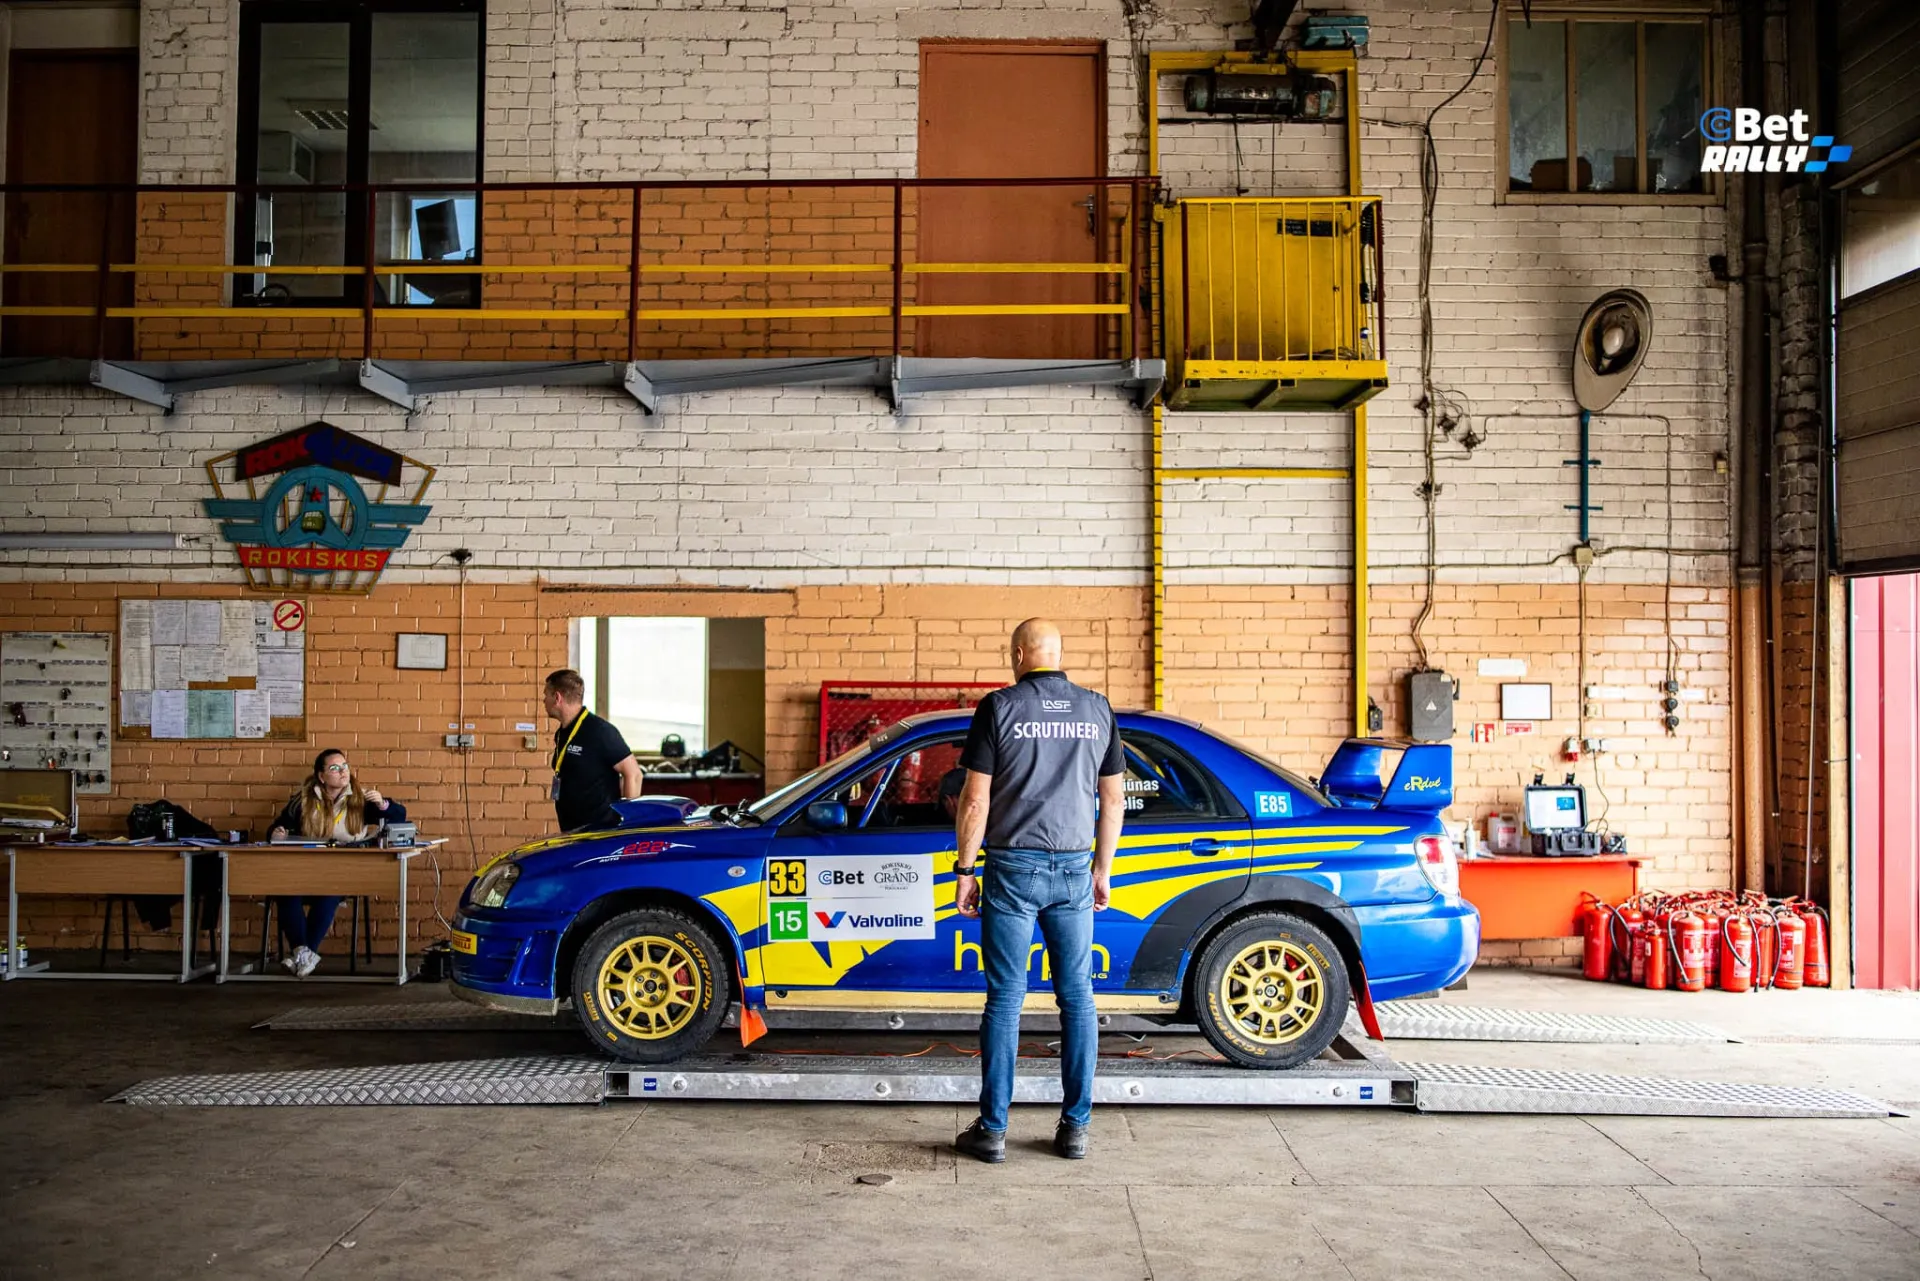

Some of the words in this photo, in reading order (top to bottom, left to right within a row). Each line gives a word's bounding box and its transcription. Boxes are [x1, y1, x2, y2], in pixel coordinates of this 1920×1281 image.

[248, 550, 379, 568] ROKISKIS
[1013, 721, 1099, 740] SCRUTINEER
[1122, 778, 1160, 792] iūnas
[1122, 796, 1144, 810] elis
[1259, 795, 1288, 814] E85
[769, 861, 806, 895] 33
[873, 871, 919, 884] GRAND
[774, 910, 803, 932] 15
[849, 914, 924, 928] Valvoline
[675, 931, 713, 1012] SCORPION
